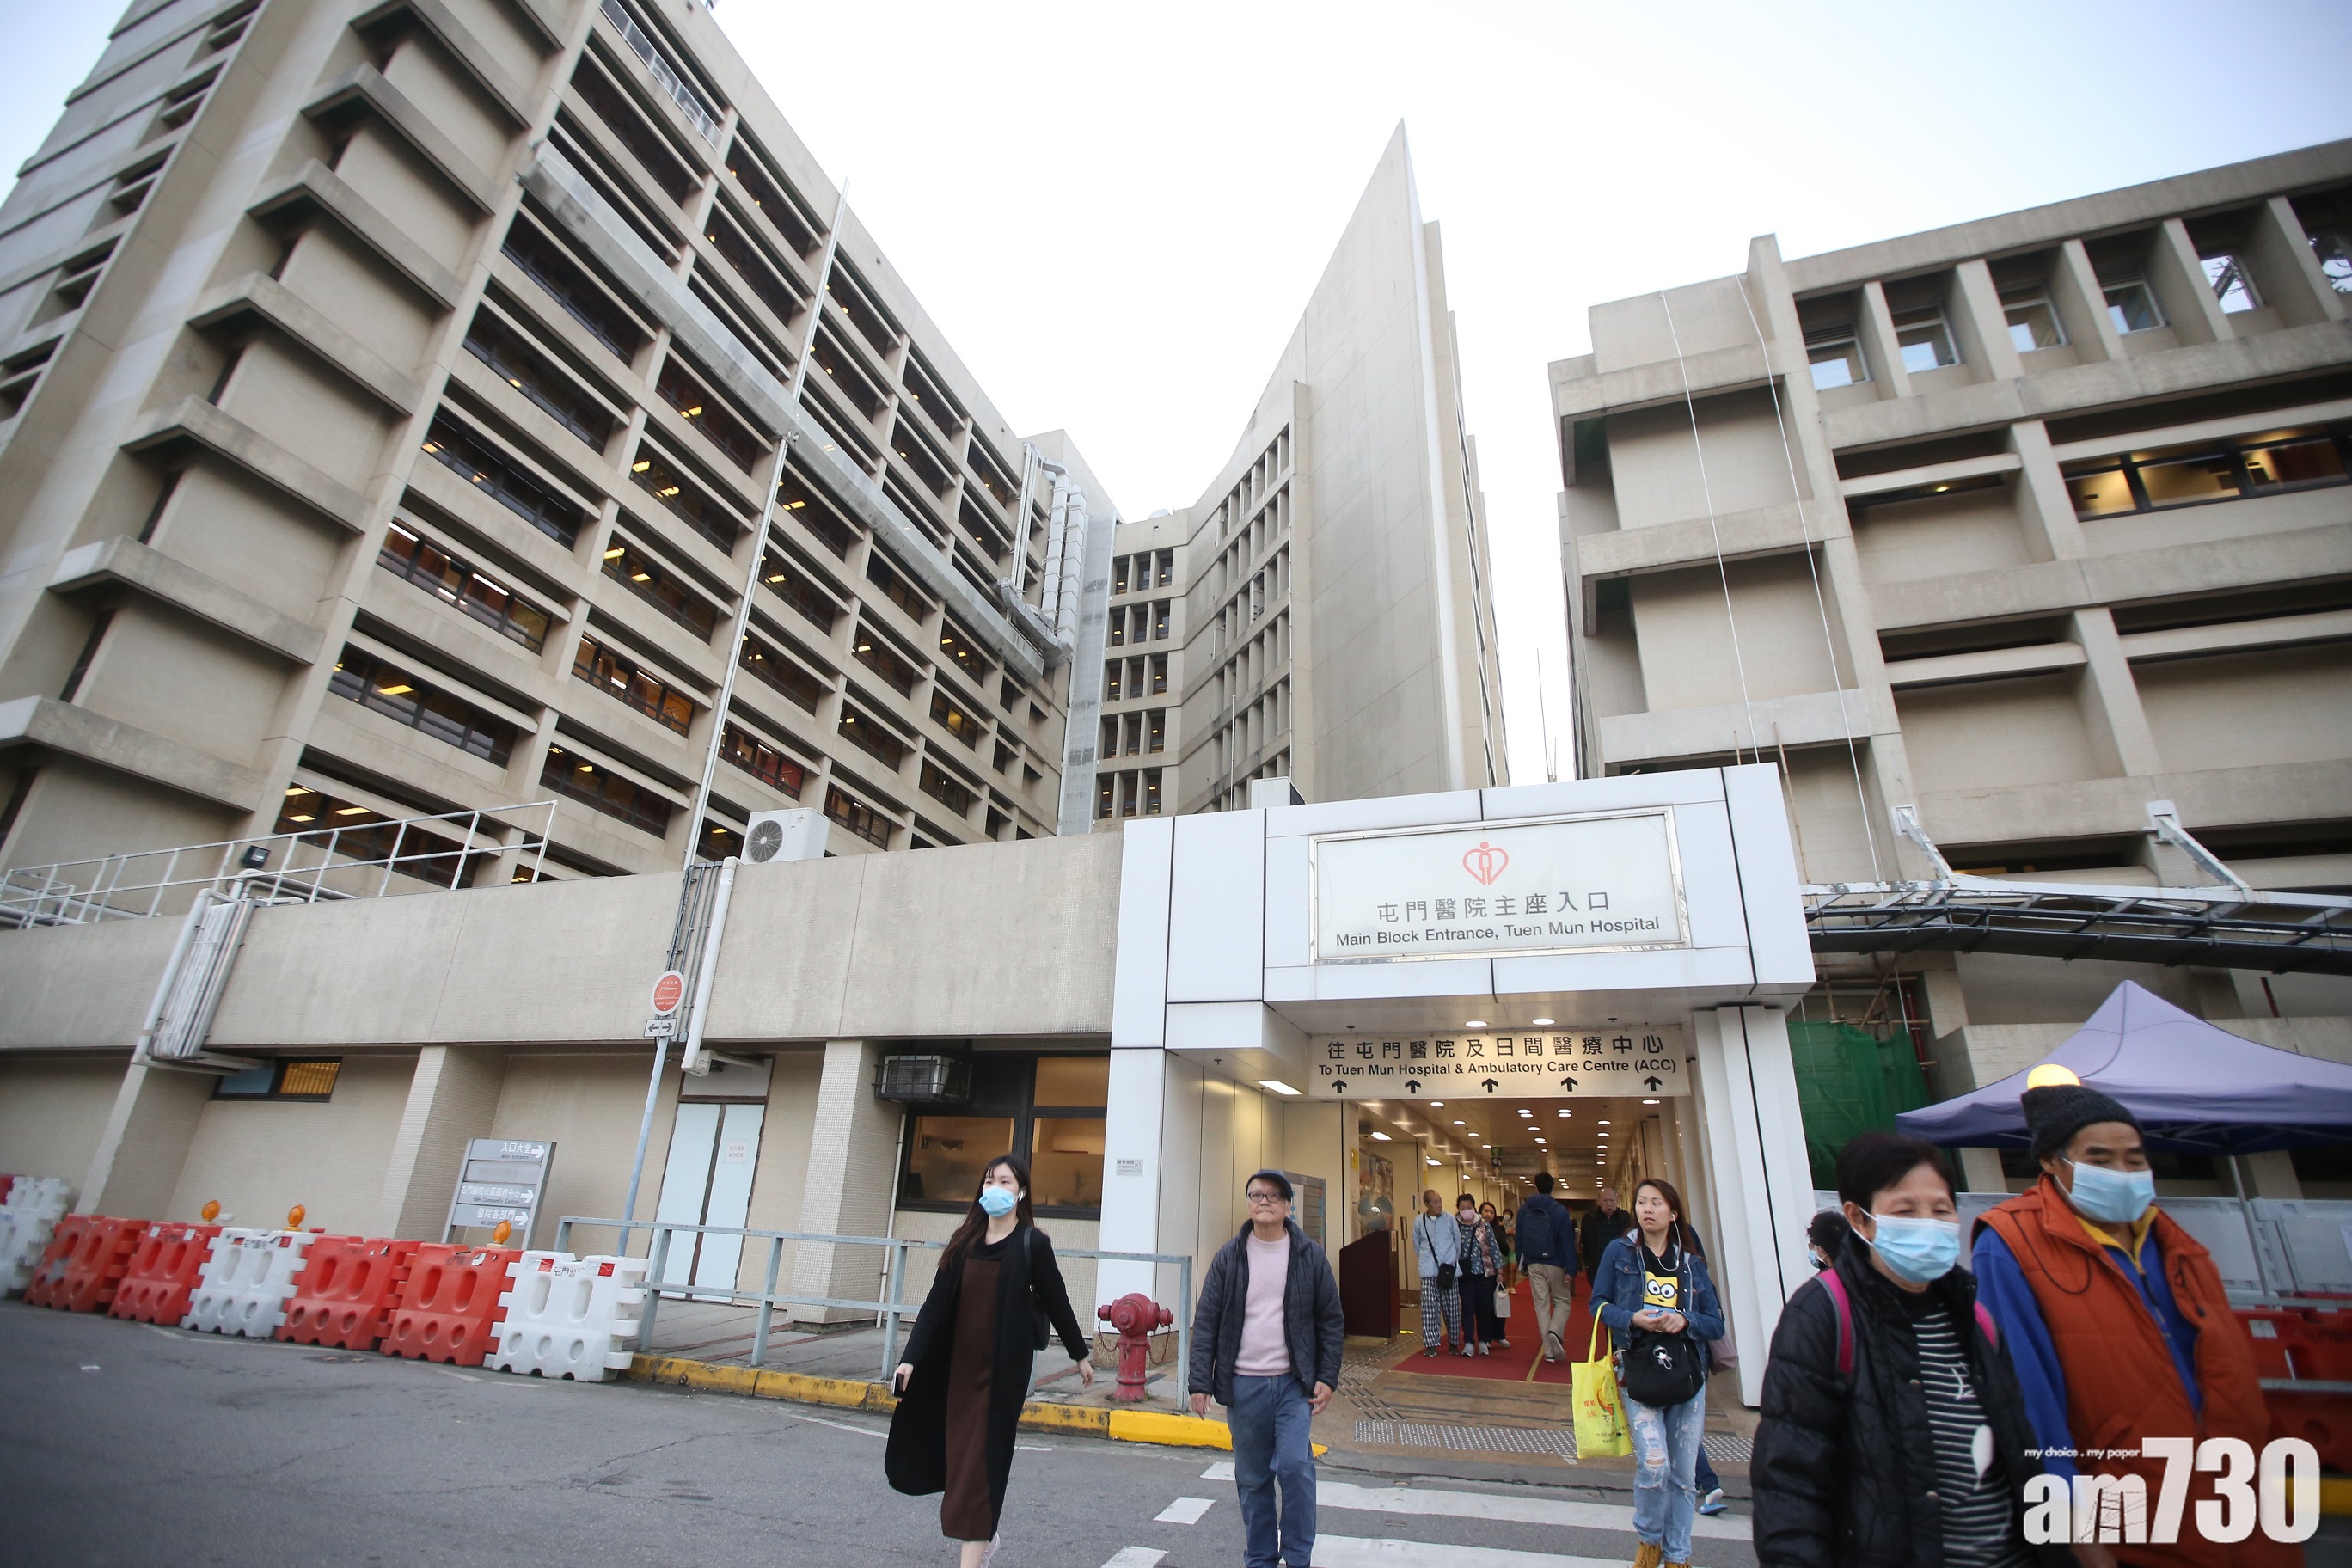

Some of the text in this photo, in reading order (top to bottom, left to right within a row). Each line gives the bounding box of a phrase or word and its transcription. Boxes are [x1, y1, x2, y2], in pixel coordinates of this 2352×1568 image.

[1377, 892, 1609, 922] 屯門醫院主座入口
[1336, 916, 1660, 946] Main Block Entrance, Tuen Mun Hospital
[1327, 1034, 1664, 1060] 往屯門醫院及日間醫療中心
[1319, 1058, 1676, 1076] To Tuen Mun Hospital & Ambulatory Care Centre (ACC)
[501, 1142, 531, 1154] 入口大堂
[477, 1208, 516, 1221] 醫院各部門
